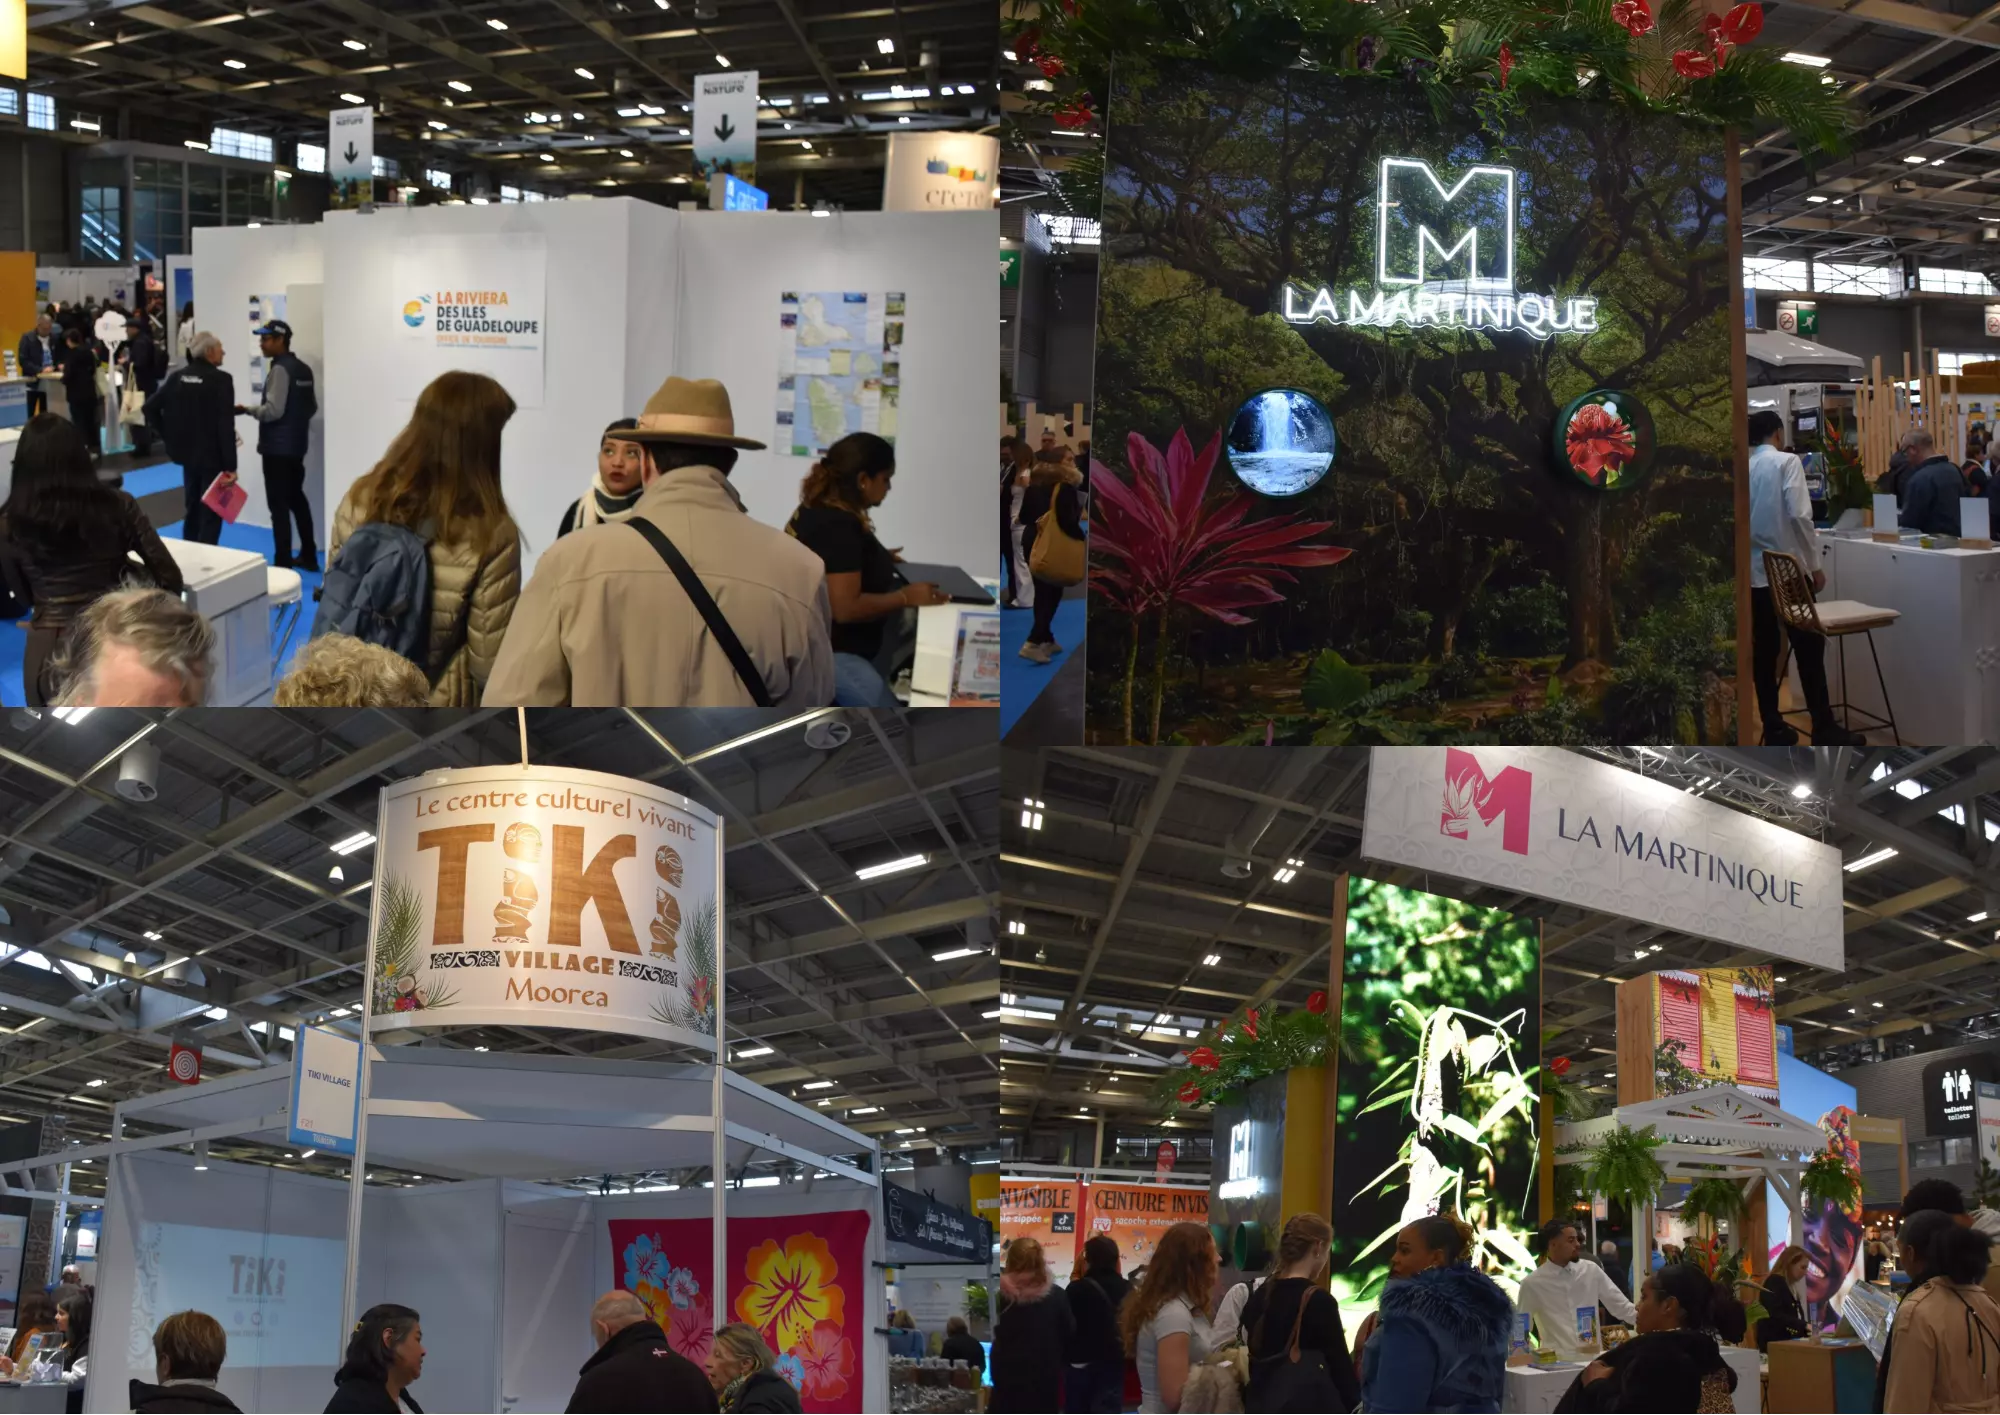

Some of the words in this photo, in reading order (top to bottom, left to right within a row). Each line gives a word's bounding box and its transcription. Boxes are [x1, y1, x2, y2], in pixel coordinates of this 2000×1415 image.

[1380, 158, 1514, 290] M
[436, 291, 453, 305] LA
[455, 291, 509, 305] RIVIERA
[436, 305, 460, 318] DES
[462, 306, 486, 319] ILES
[1285, 286, 1339, 321] LA
[1350, 290, 1598, 336] MARTINIQUE
[436, 319, 452, 332] DE
[454, 320, 538, 333] GUADELOUPE
[416, 796, 440, 818] Le
[447, 790, 528, 813] centre
[536, 788, 631, 820] culturel
[638, 806, 697, 842] vivant
[1558, 808, 1602, 848] LA
[1615, 824, 1804, 910] MARTINIQUE
[504, 950, 615, 976] VILLAGE
[505, 977, 609, 1008] Moorea
[308, 1069, 322, 1081] TIKI
[322, 1072, 351, 1088] VILLAGE
[1944, 1105, 1974, 1114] toilettes
[1947, 1113, 1970, 1121] toilets
[1095, 1189, 1167, 1213] CEINTURE
[1172, 1194, 1209, 1214] INVIS
[1115, 1216, 1147, 1226] sacoche
